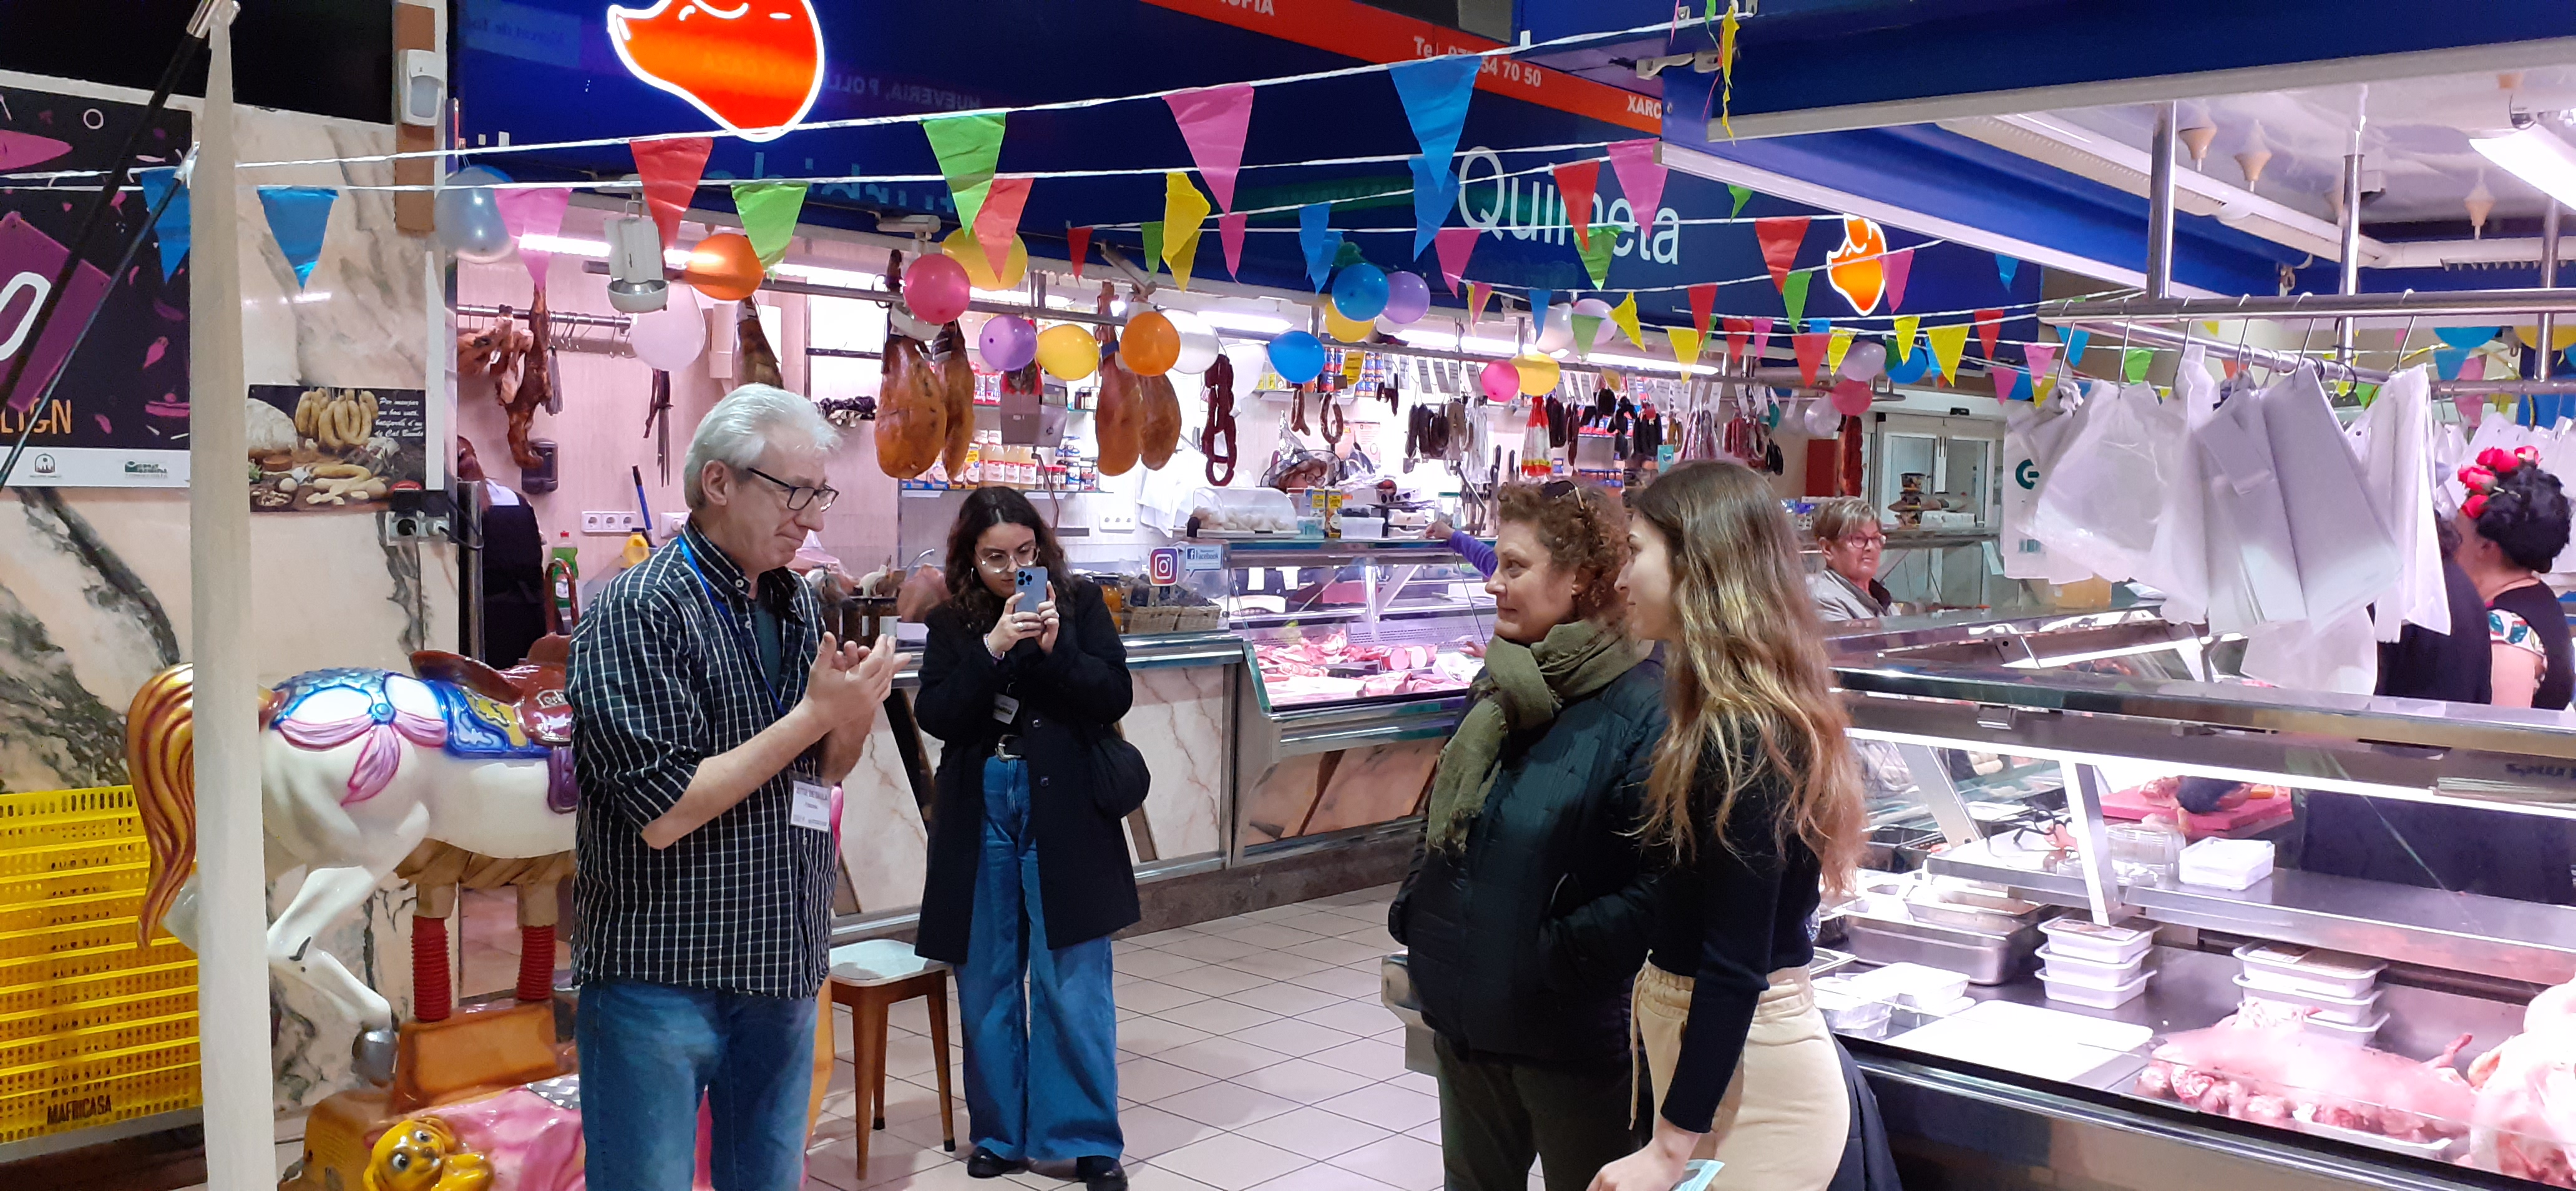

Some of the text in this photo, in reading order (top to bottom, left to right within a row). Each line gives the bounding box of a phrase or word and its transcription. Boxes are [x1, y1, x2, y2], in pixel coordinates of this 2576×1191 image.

[1480, 56, 1498, 76] 54
[1502, 61, 1520, 81] 70
[1523, 66, 1542, 87] 50
[1627, 94, 1662, 120] XARC
